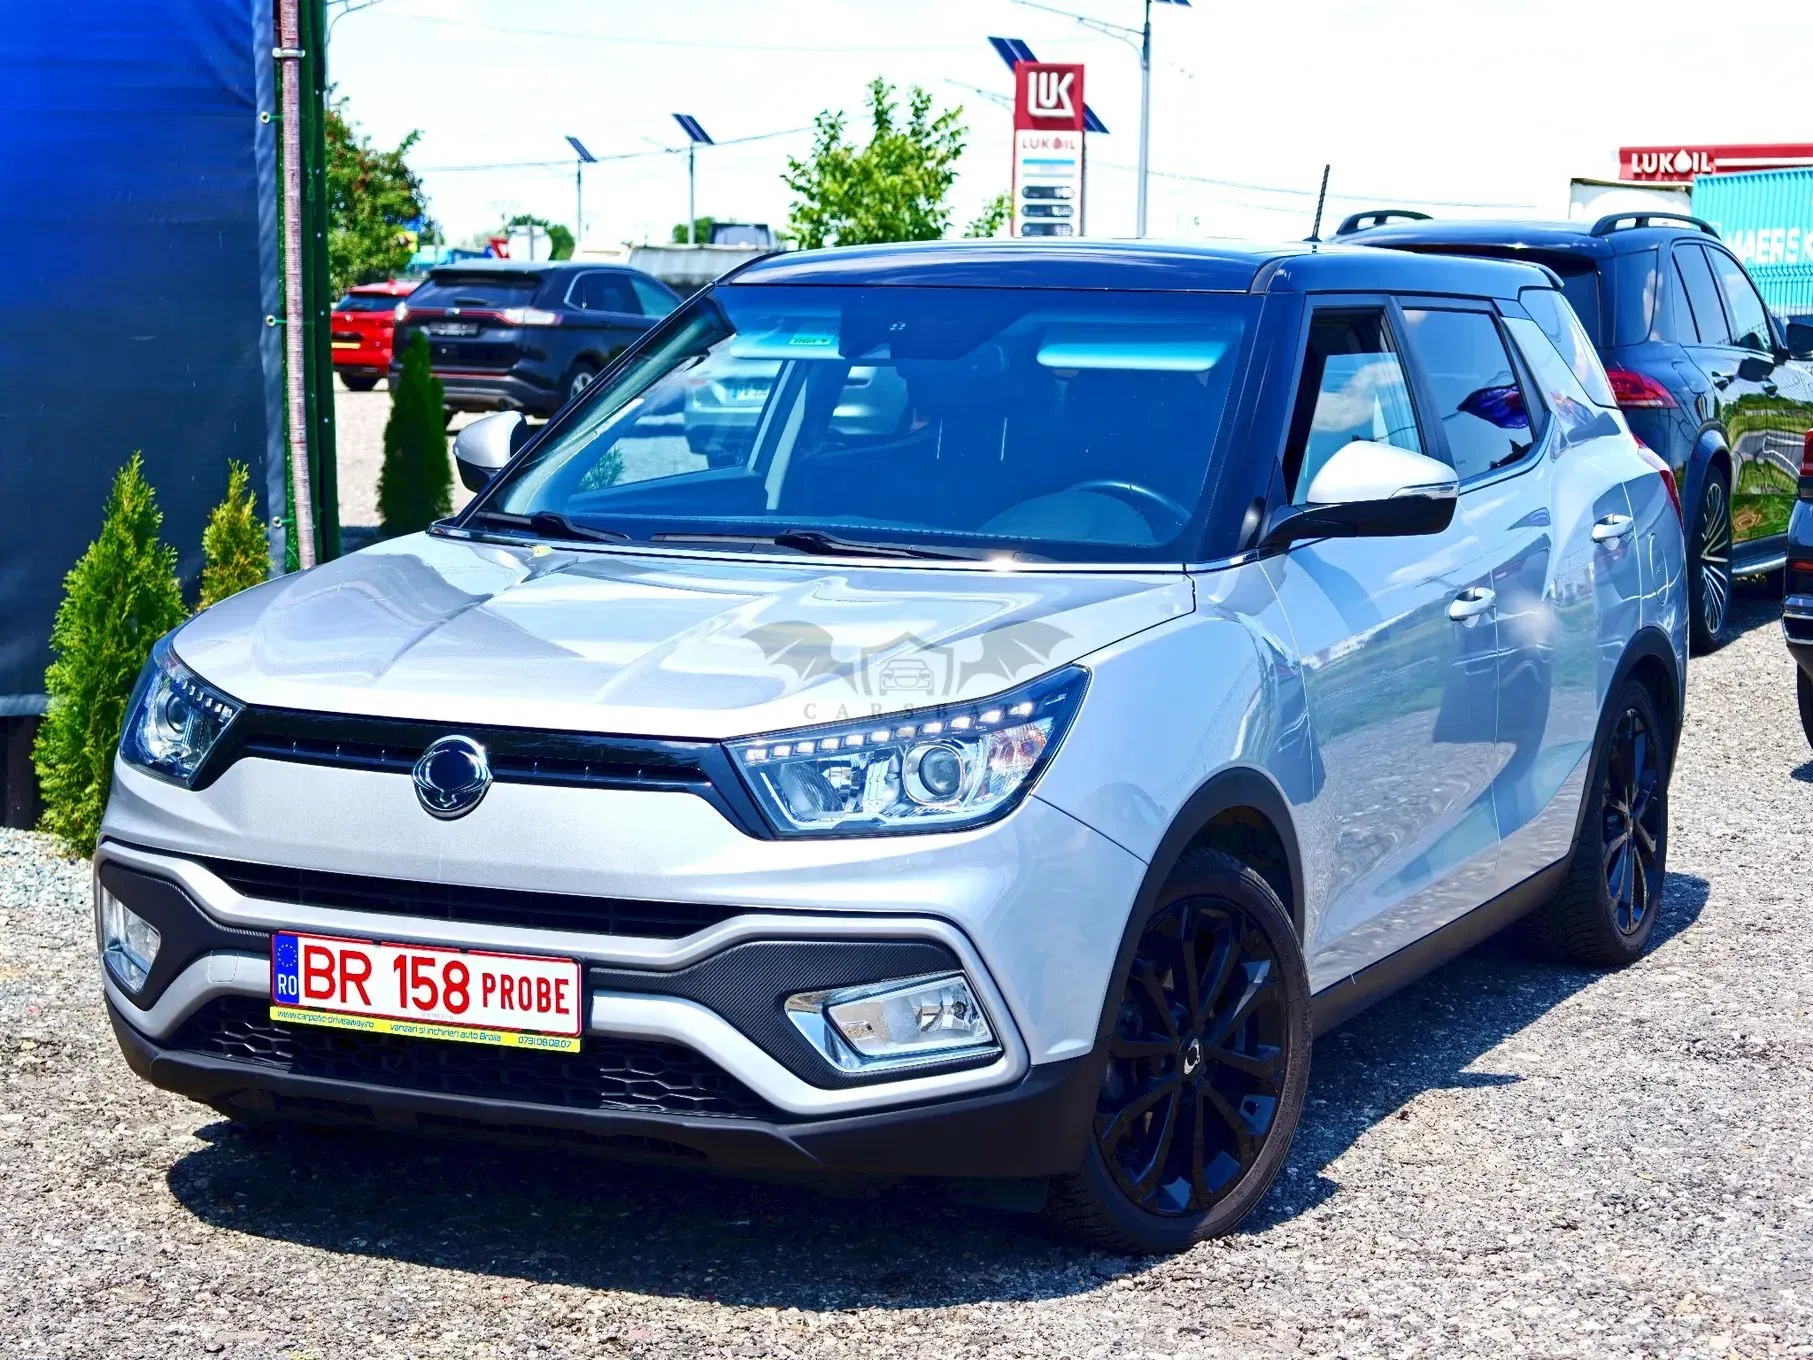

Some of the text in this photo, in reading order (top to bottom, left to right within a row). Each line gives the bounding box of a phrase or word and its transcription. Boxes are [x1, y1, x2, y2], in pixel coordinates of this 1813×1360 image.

[1631, 149, 1712, 173] LUKOIL
[277, 974, 297, 995] RO
[303, 944, 570, 1015] BR 158 PROBE
[460, 1030, 478, 1040] auto
